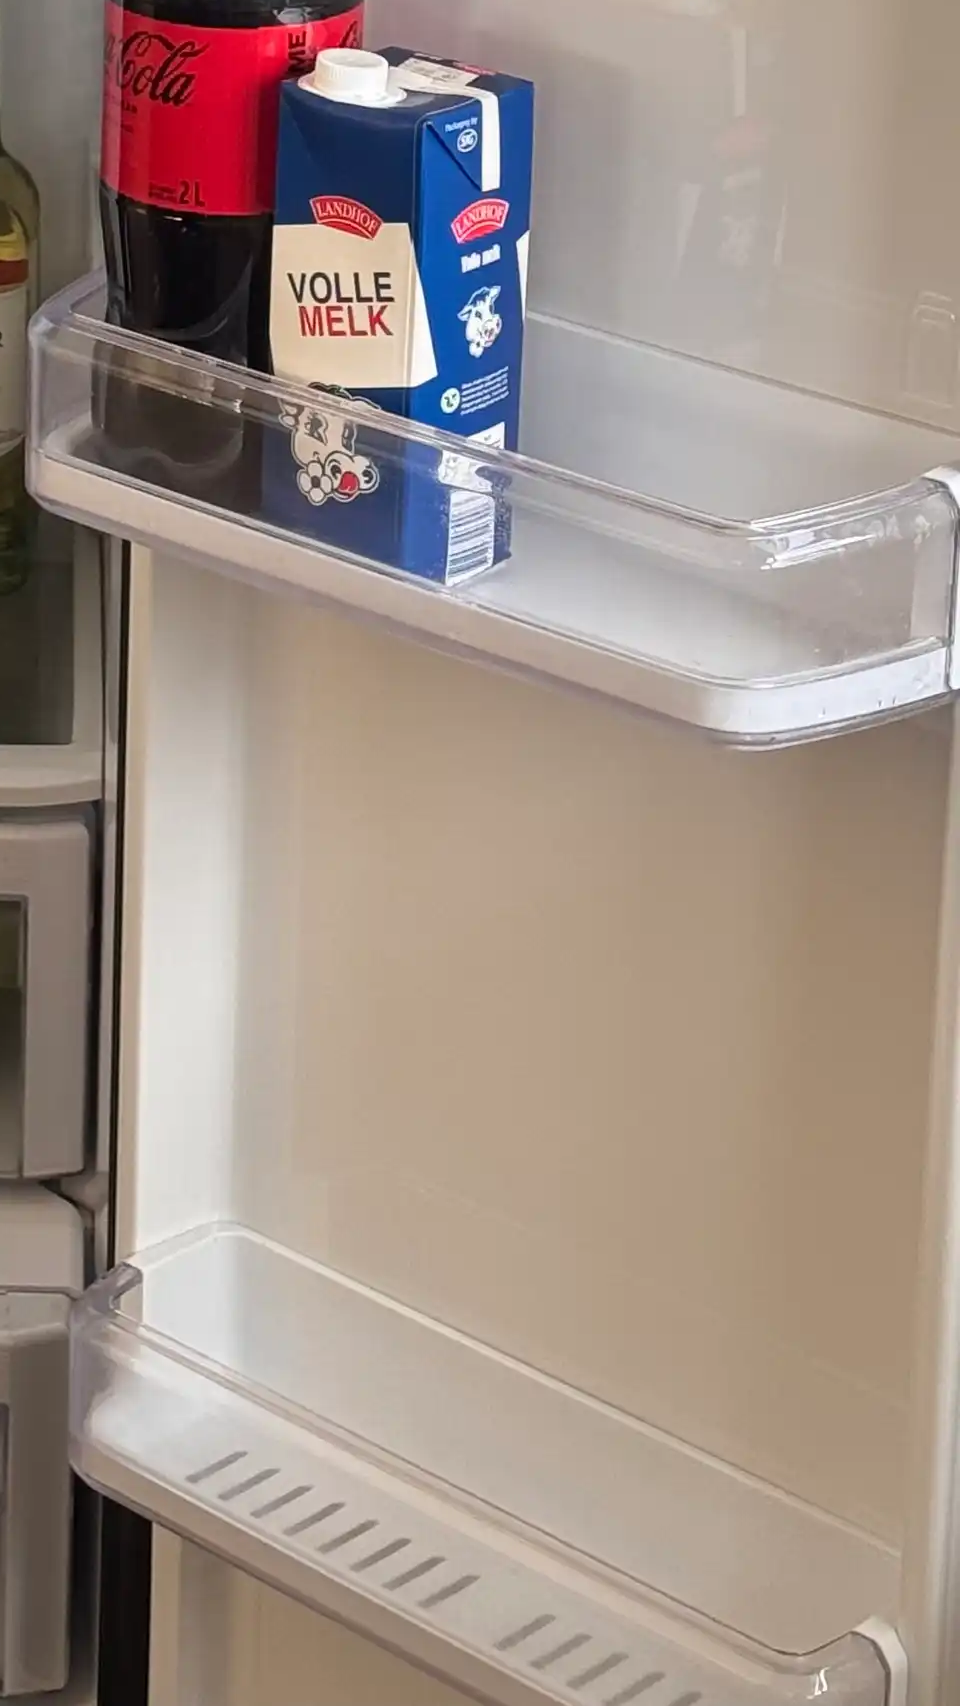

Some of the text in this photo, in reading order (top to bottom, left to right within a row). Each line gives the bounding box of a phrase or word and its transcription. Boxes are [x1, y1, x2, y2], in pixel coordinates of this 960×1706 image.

[117, 31, 210, 107] Cola
[315, 201, 379, 233] LANDHOF
[287, 271, 395, 304] VOLLE
[298, 304, 394, 337] MELK
